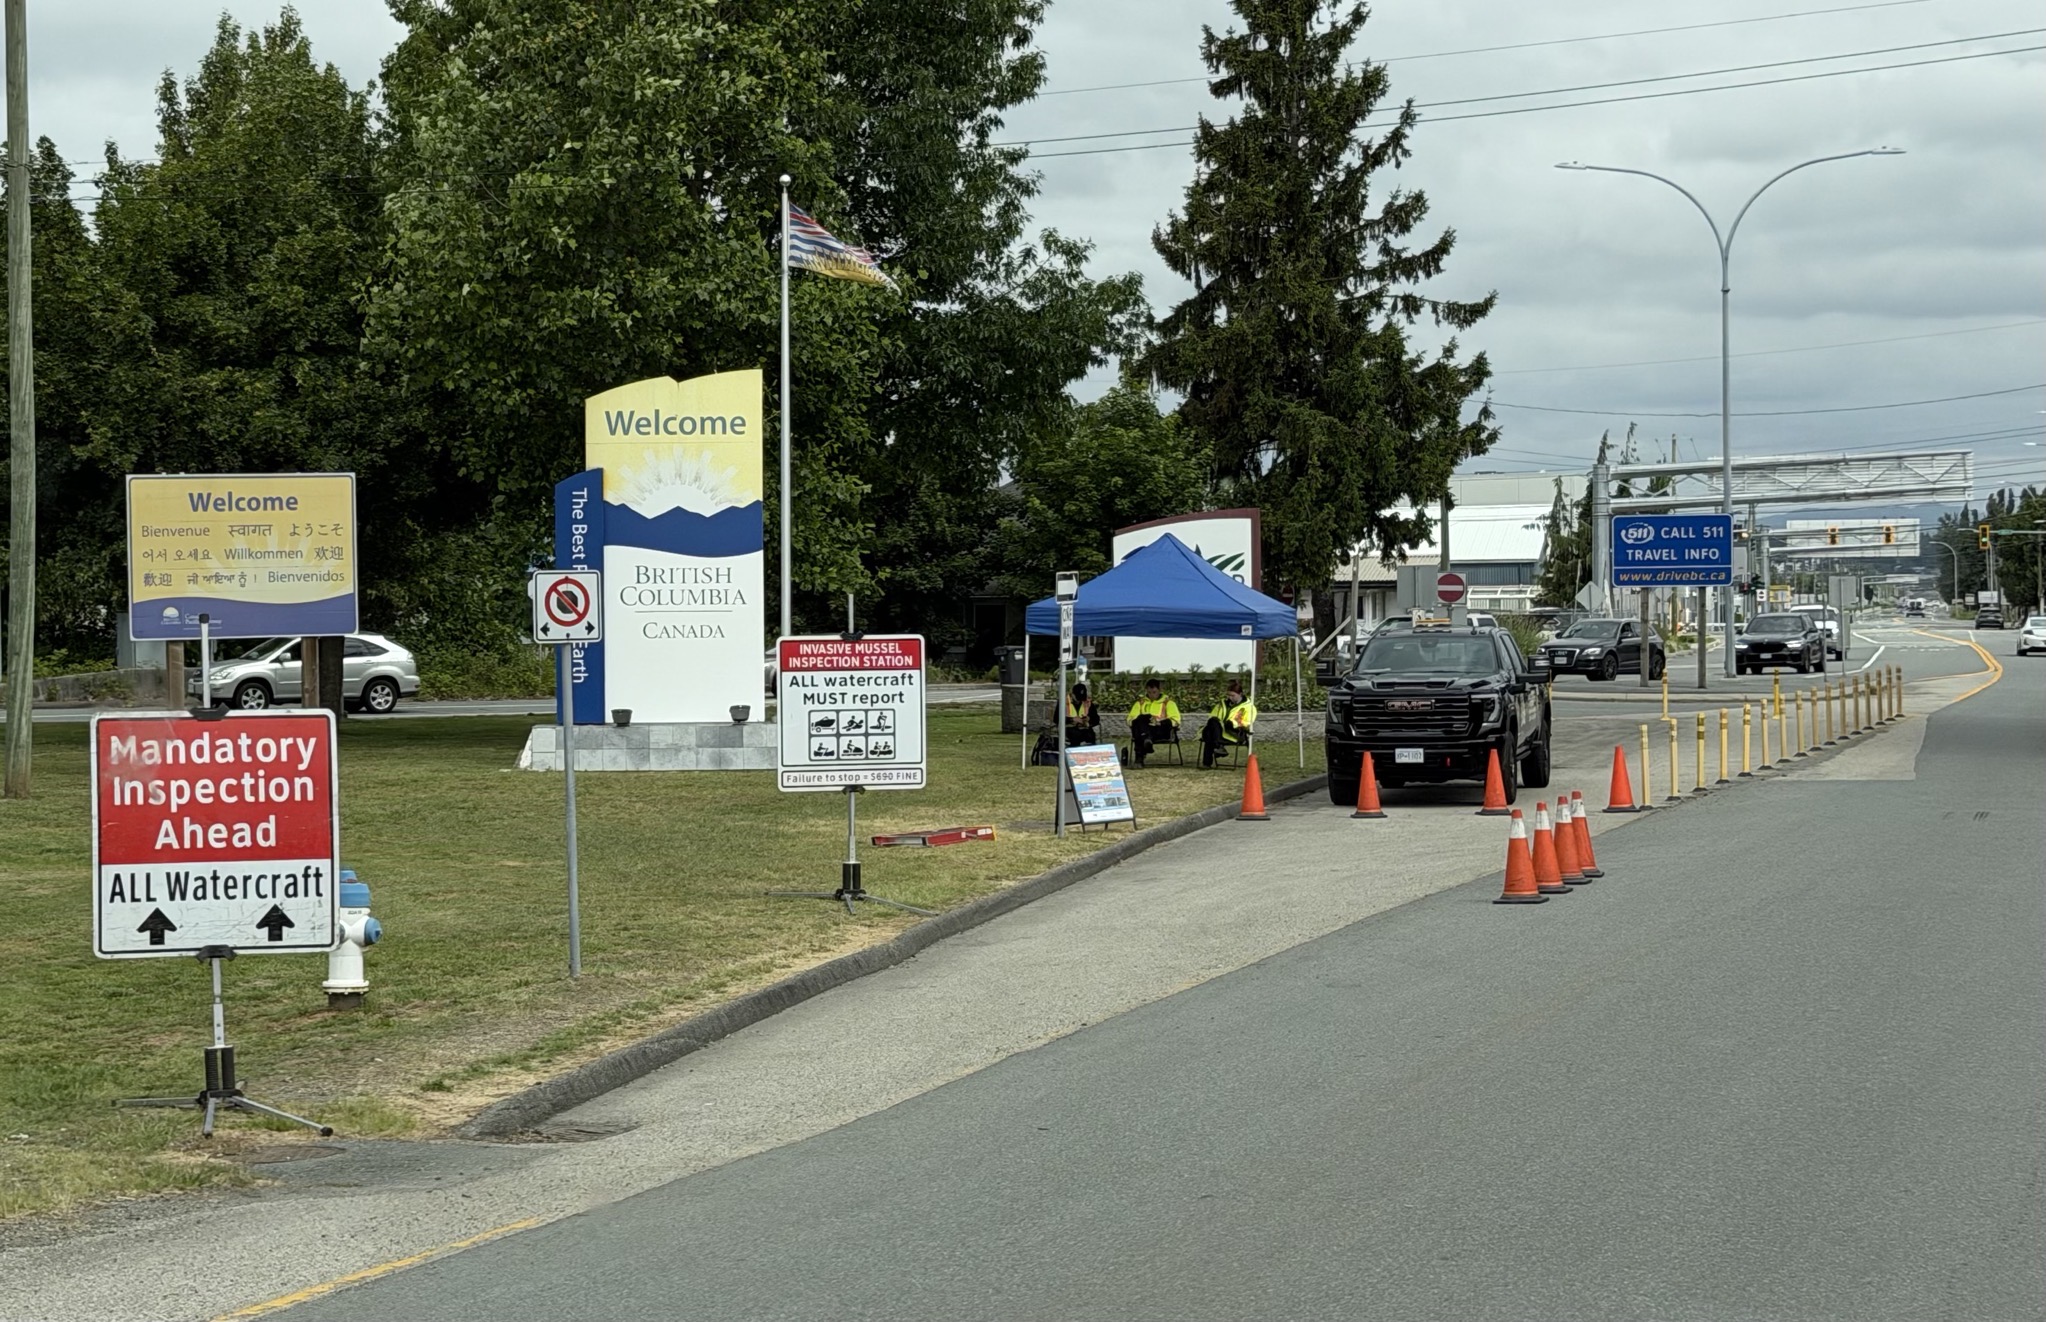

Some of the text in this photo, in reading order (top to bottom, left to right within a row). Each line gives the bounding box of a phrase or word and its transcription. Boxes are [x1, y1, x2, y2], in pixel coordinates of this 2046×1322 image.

[605, 409, 746, 436] Welcome
[188, 491, 299, 513] Welcome
[572, 487, 588, 519] The
[141, 525, 210, 538] Bienvenue
[228, 524, 273, 538] स्वागत
[289, 523, 344, 538] ようこそ
[1627, 526, 1724, 539] 511 CALL 511
[572, 524, 588, 560] Best
[142, 548, 213, 562] 어서 오세요
[224, 548, 303, 560] Willkommen
[313, 545, 344, 561] 欢迎
[1626, 548, 1719, 561] TRAVEL INFO
[268, 570, 345, 583] Bienvenidos
[634, 565, 732, 584] BRITISH
[1619, 570, 1726, 581] www.drivebc.ca
[620, 586, 747, 606] COLUMBIA
[643, 622, 725, 639] CANADA
[799, 642, 902, 655] INVASIVE MUSSEL
[789, 655, 913, 668] INSPECTION STATION
[789, 673, 914, 688] ALL watercraft
[803, 691, 905, 707] MUST report
[110, 732, 317, 770] Mandatory
[786, 774, 823, 783] Failure
[825, 774, 836, 782] to
[838, 773, 861, 783] stop
[896, 771, 918, 780] FINE
[113, 770, 314, 813] Inspection
[154, 815, 277, 850] Ahead
[109, 865, 324, 903] ALL Watercraft
